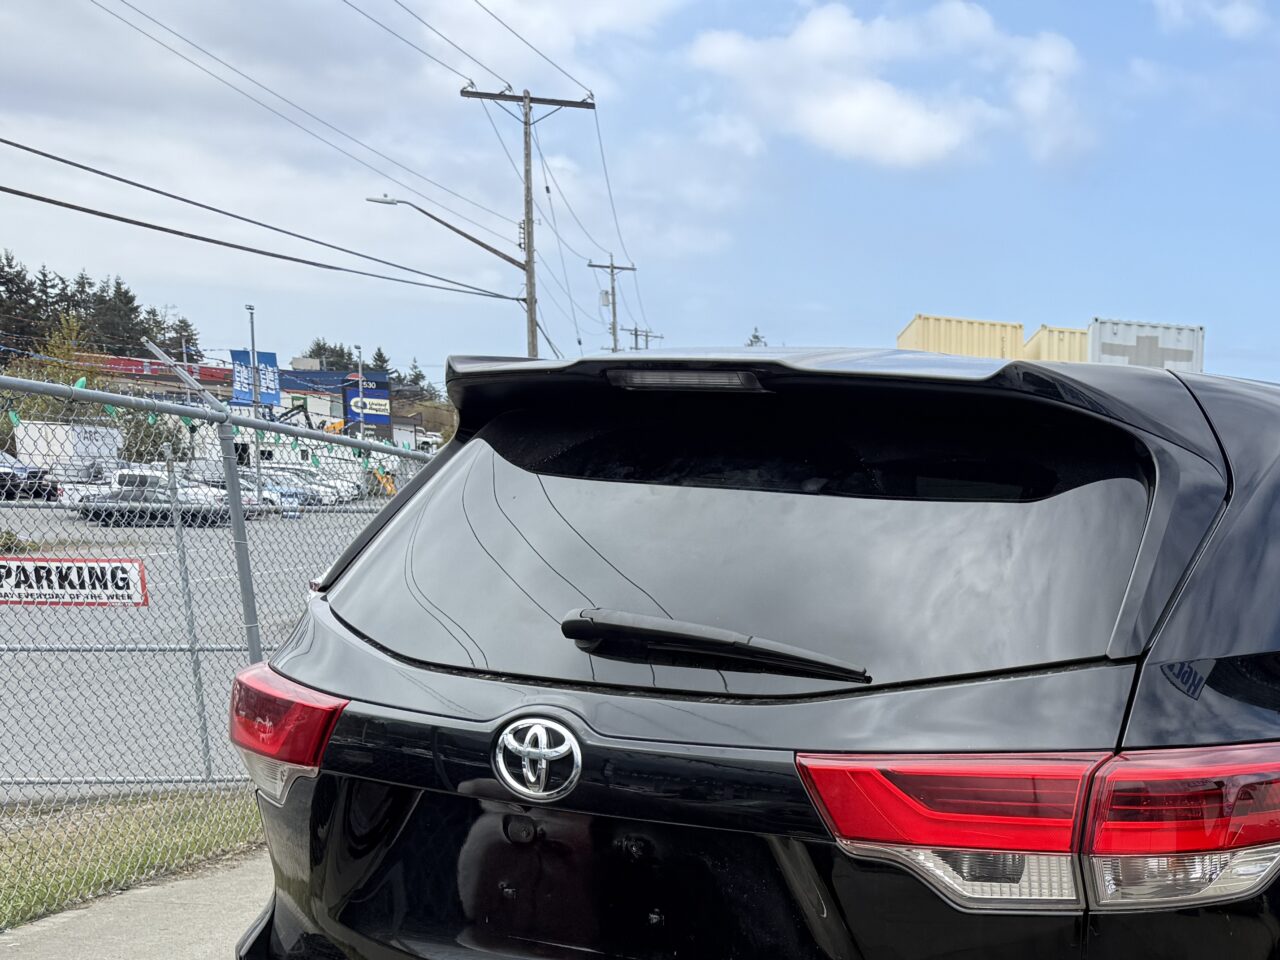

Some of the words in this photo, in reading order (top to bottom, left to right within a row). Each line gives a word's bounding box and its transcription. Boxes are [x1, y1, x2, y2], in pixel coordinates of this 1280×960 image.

[0, 564, 132, 591] PARKING
[18, 592, 66, 600] EVERYDAY
[107, 593, 133, 601] WEEK
